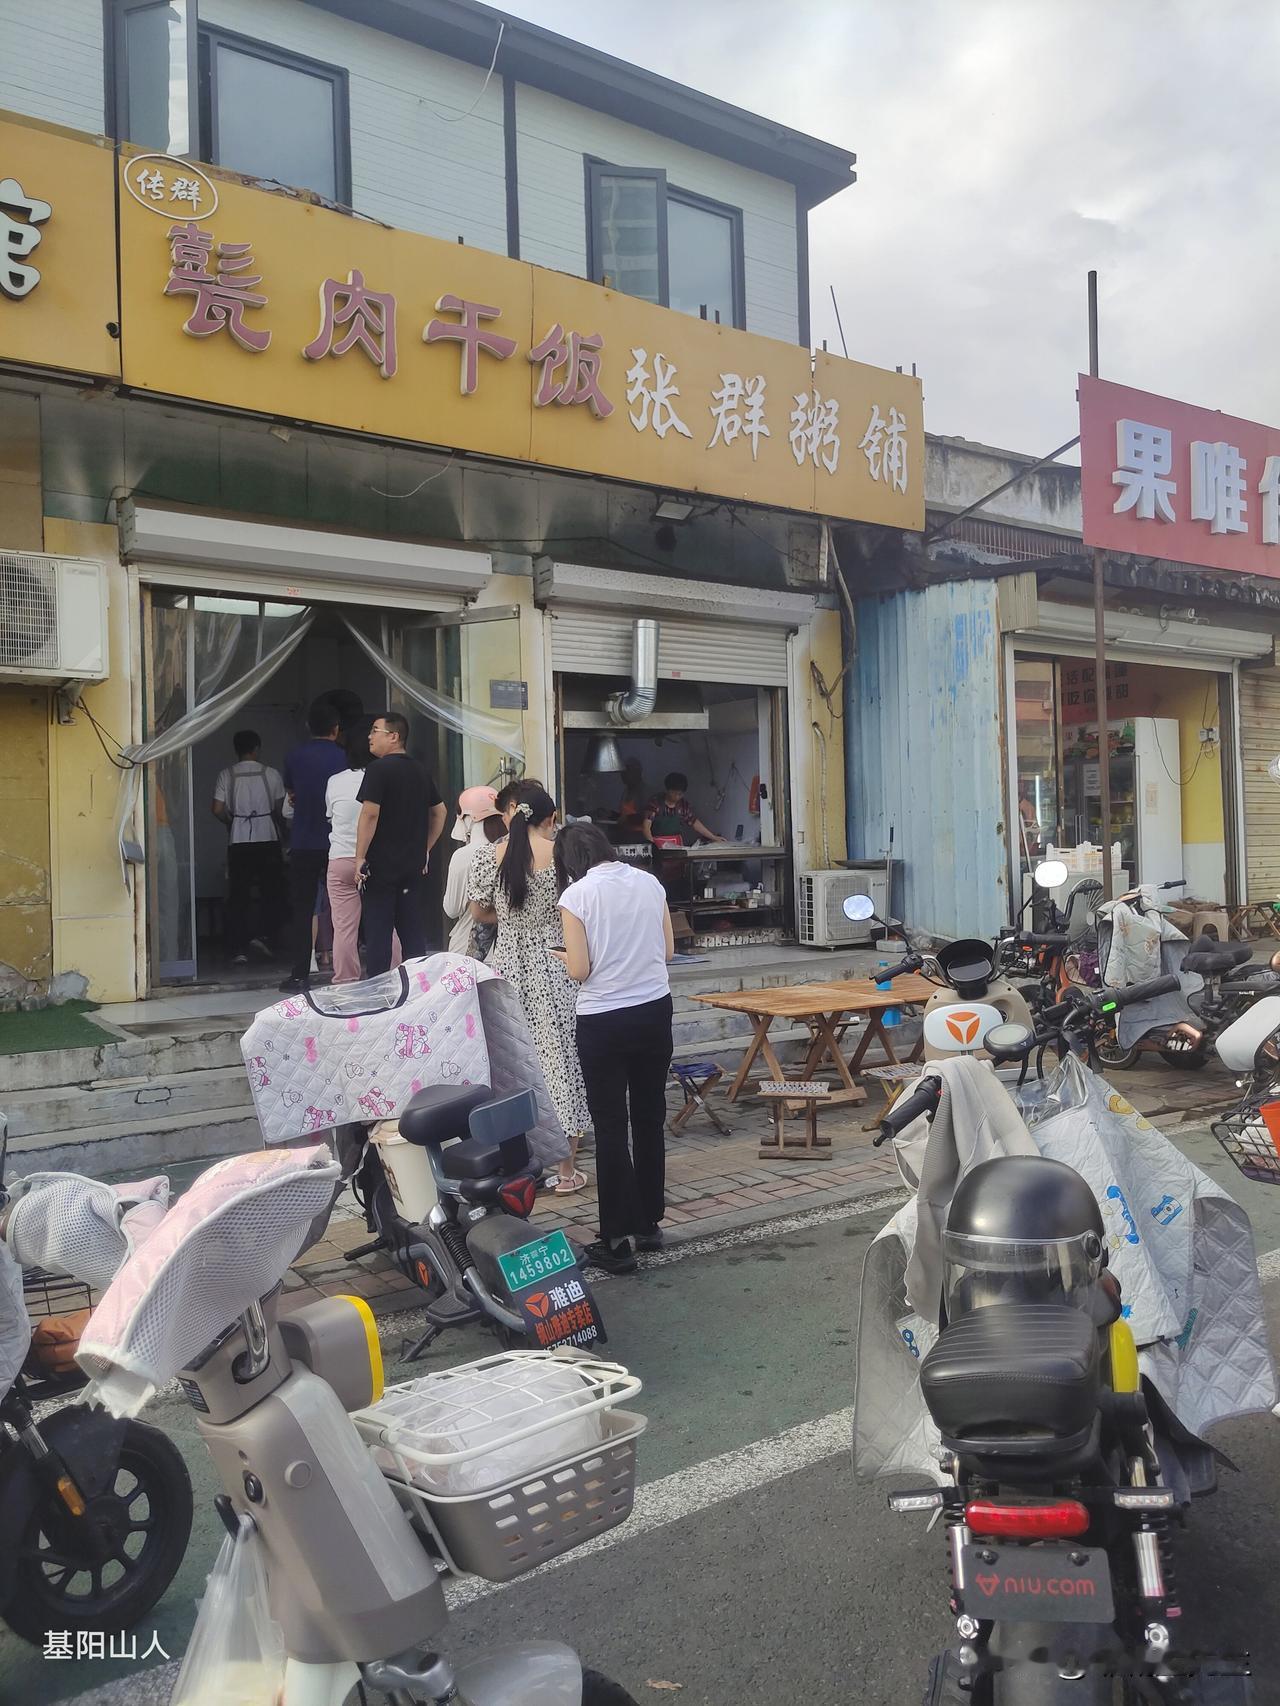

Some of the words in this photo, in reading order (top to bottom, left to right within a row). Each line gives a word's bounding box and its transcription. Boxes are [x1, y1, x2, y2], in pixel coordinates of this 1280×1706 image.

[626, 346, 908, 495] 张群粥铺
[510, 1248, 570, 1285] 1459802
[548, 1280, 586, 1311] 雅迪
